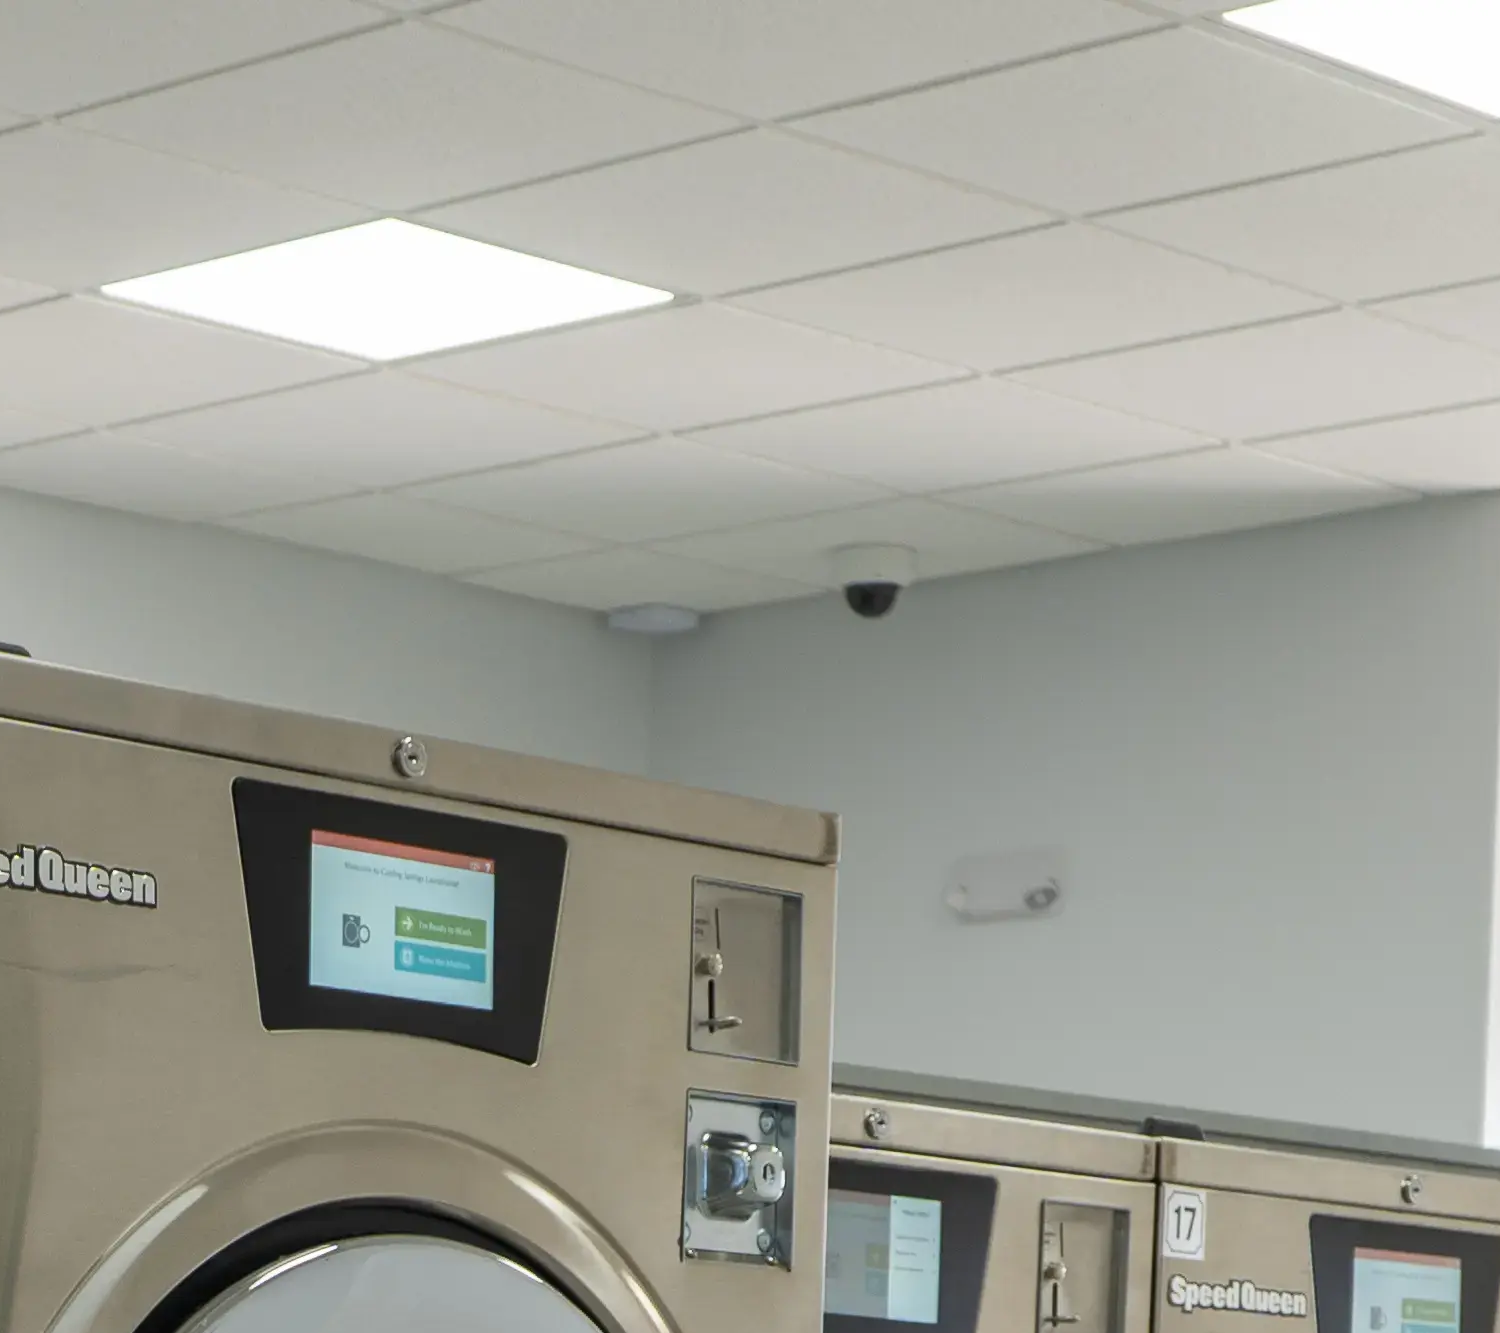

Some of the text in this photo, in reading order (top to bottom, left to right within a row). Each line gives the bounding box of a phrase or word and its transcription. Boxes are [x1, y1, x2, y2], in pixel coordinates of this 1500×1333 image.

[38, 849, 158, 909] Queen
[1173, 1205, 1197, 1241] 17
[1168, 1273, 1308, 1318] Speed Queen
